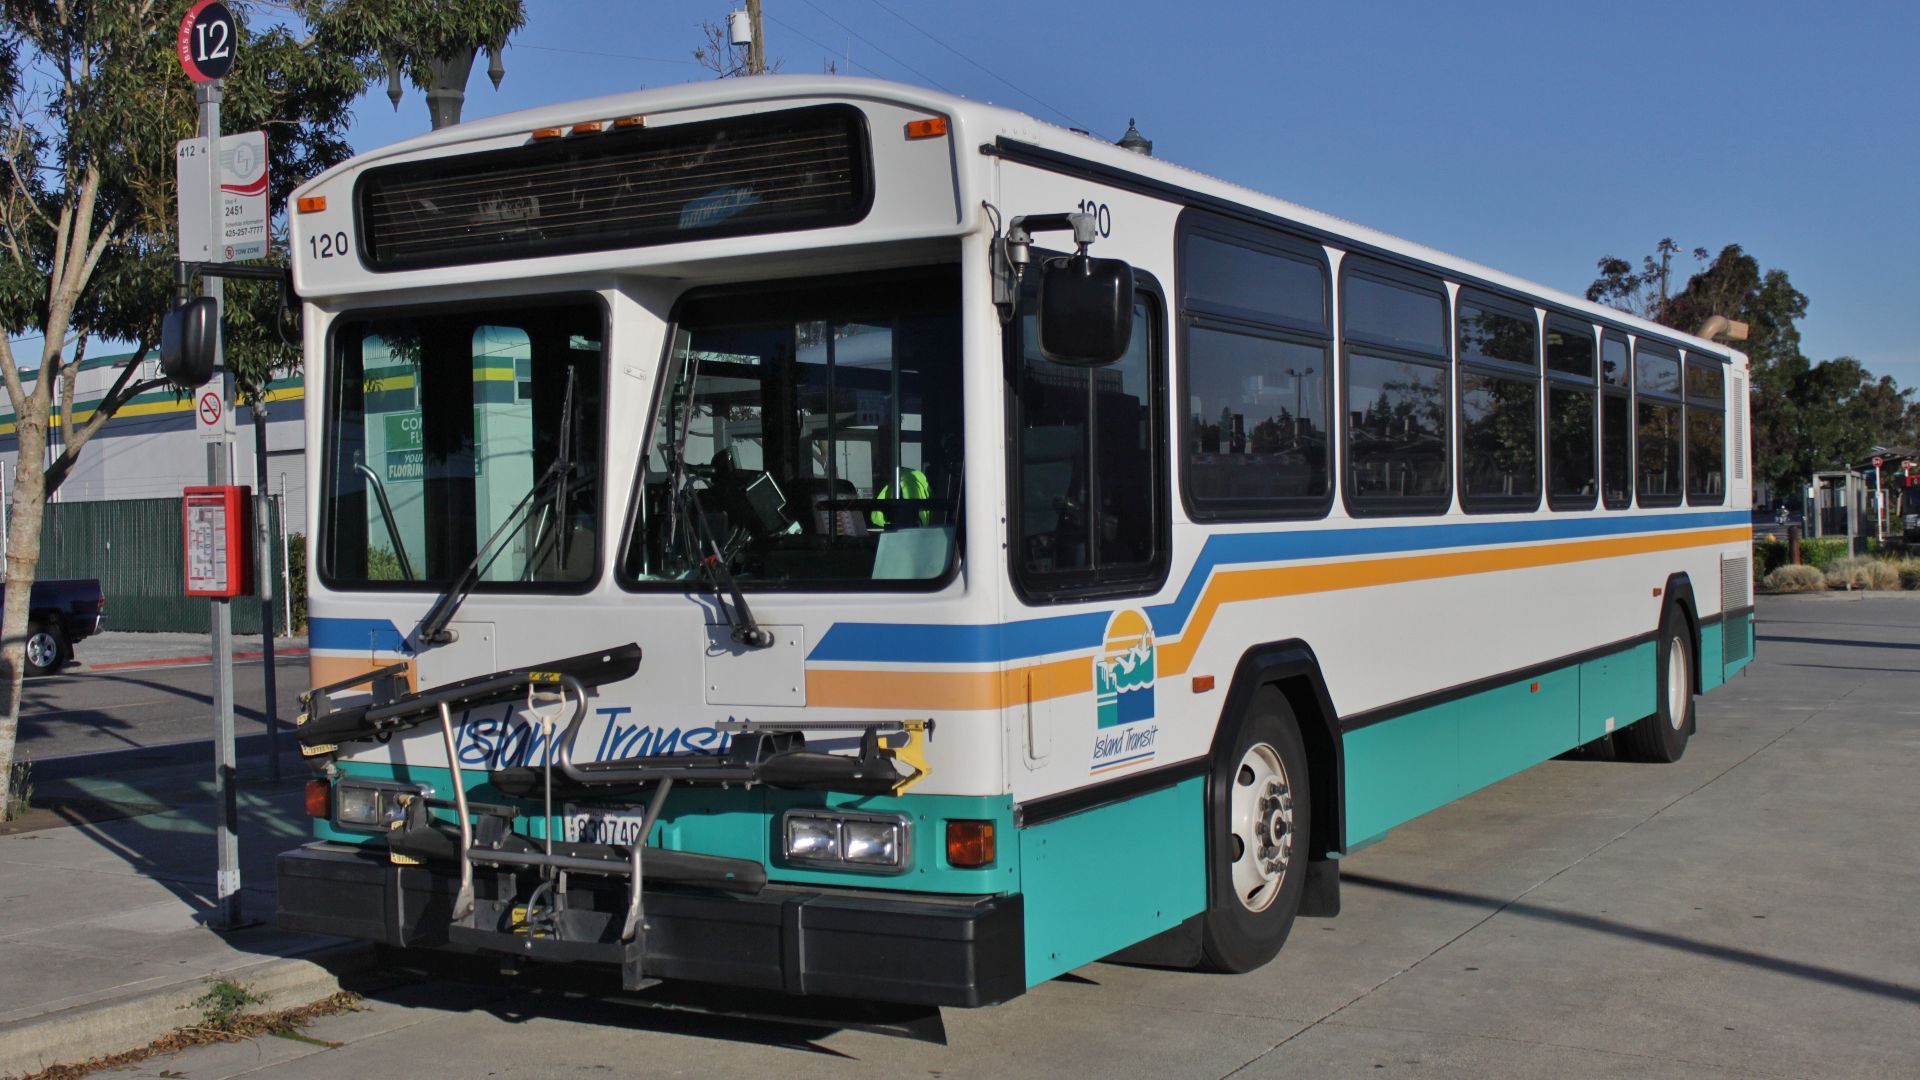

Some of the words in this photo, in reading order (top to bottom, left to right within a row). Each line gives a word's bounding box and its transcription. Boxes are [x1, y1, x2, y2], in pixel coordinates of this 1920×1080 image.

[196, 20, 229, 61] 12
[183, 38, 191, 62] BUS
[179, 145, 196, 158] 412
[225, 205, 243, 217] 2451
[225, 225, 264, 238] 425-257-7777
[235, 248, 246, 256] TOW
[310, 231, 348, 260] 120
[401, 417, 422, 431] CO
[411, 431, 422, 444] FL
[595, 707, 751, 762] Transi
[1093, 730, 1124, 759] Island
[1125, 724, 1158, 752] Transit
